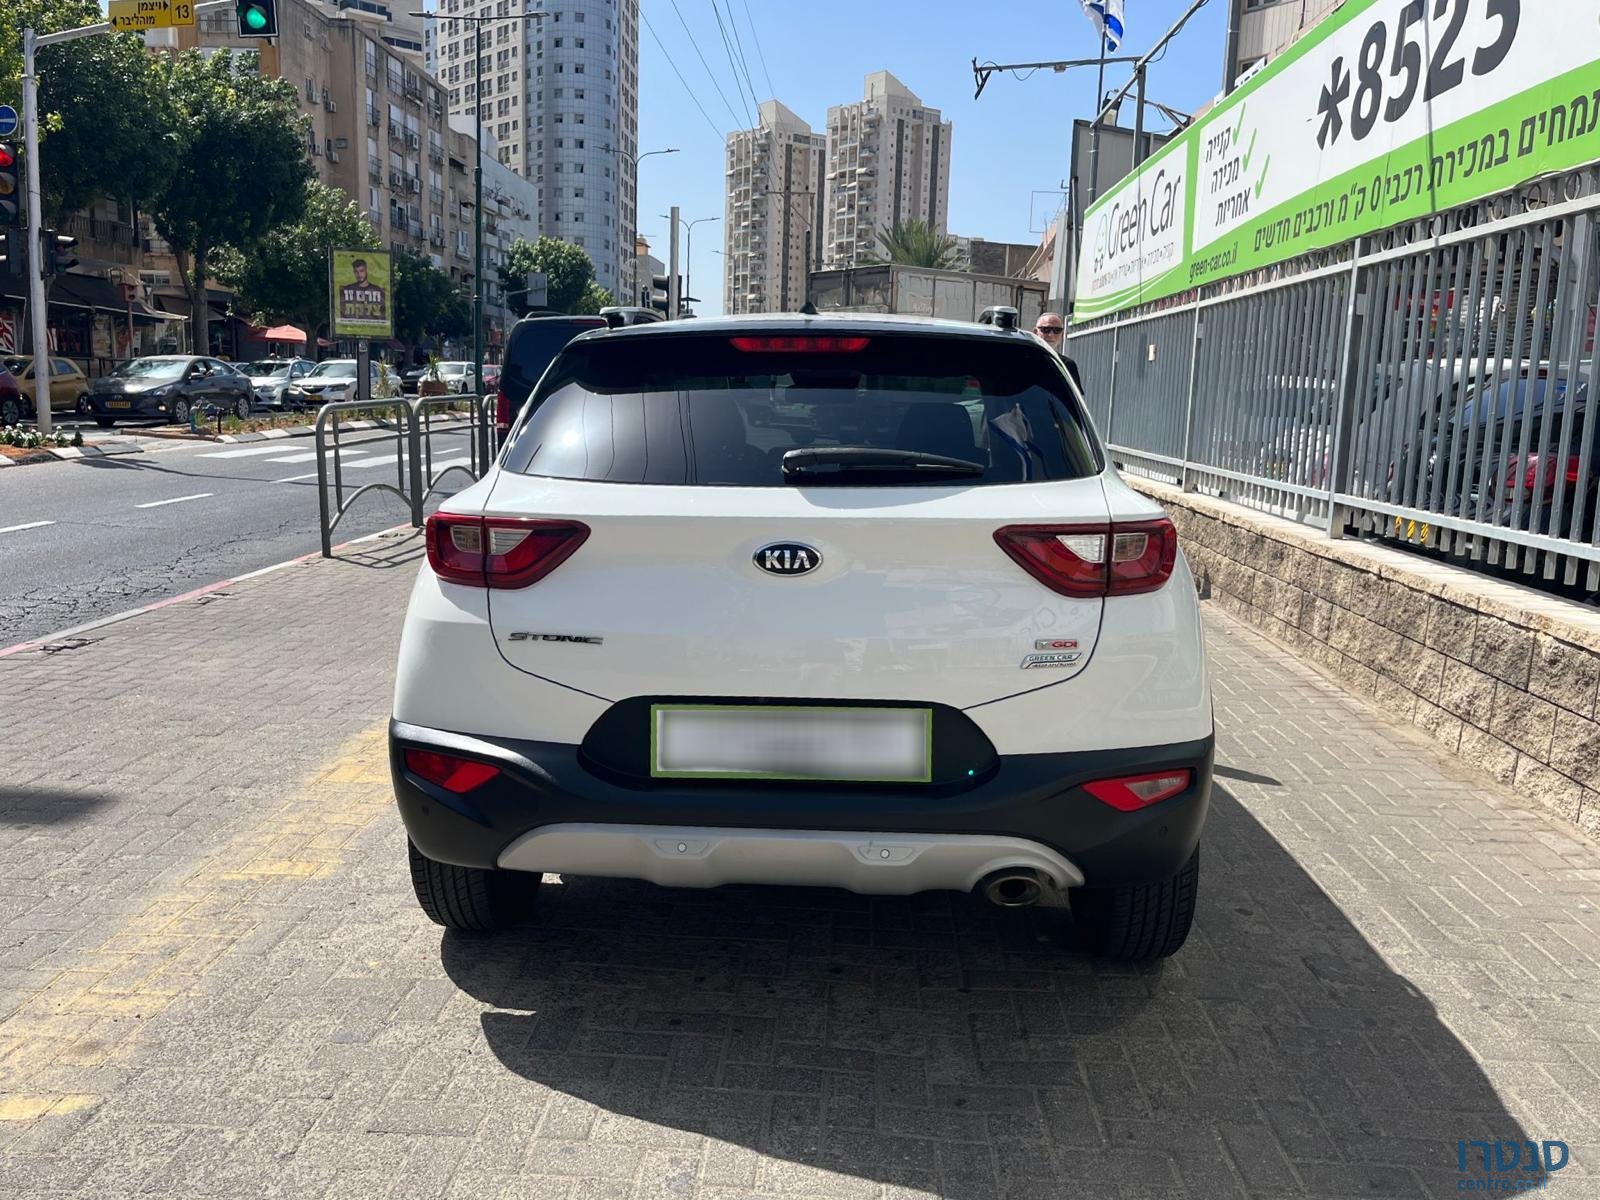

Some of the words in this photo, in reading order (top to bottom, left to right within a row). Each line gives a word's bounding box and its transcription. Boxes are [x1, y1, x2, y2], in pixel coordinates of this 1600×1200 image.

[120, 13, 156, 26] מוהליבר
[138, 2, 161, 14] ויצמן
[175, 4, 189, 19] 13
[1206, 126, 1231, 163] קנייה
[1427, 128, 1510, 191] במכירת
[1211, 156, 1239, 194] מכירה
[1386, 164, 1424, 205] רכבי
[1108, 198, 1147, 259] Green
[1150, 169, 1181, 237] Car
[1216, 187, 1251, 227] אחריות
[1293, 199, 1335, 238] ורכבים
[1254, 217, 1291, 252] חדשים
[1189, 241, 1238, 284] green-car.co.il
[765, 549, 811, 569] KIA
[508, 631, 604, 645] STONIC
